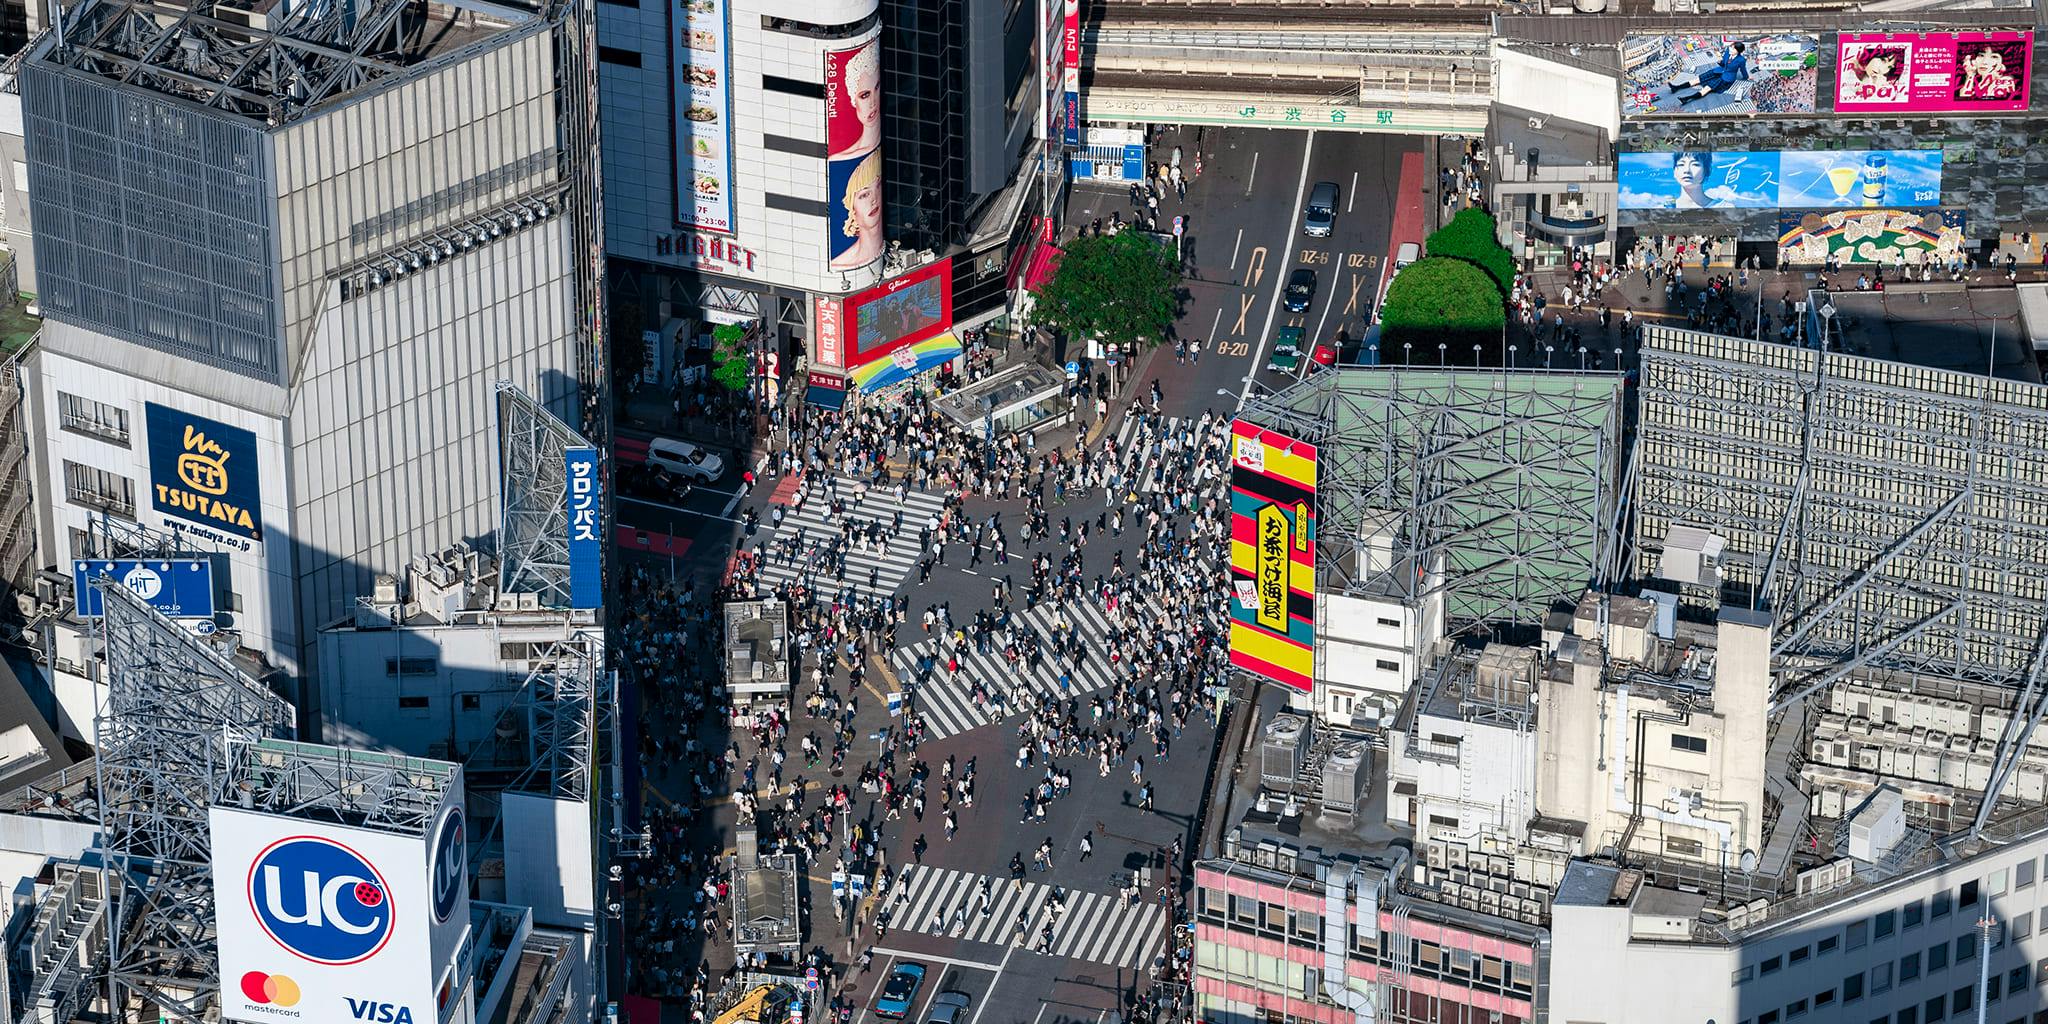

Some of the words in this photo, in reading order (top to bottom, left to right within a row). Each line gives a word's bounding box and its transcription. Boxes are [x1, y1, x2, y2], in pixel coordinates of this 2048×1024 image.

[827, 53, 838, 78] 4.28
[827, 82, 838, 118] Debut!
[1637, 94, 1651, 103] 50
[1239, 106, 1257, 117] JR
[1286, 107, 1393, 124] 渋谷駅
[697, 206, 709, 214] 7F
[656, 231, 758, 272] MAGNET
[821, 308, 836, 365] 天津甘栗
[1217, 341, 1250, 357] 8-20
[811, 375, 842, 388] 天津甘栗
[156, 483, 255, 529] TSUTAYA
[571, 461, 596, 541] サロンパス
[163, 518, 251, 552] www.tsutaya.co.jp
[129, 572, 156, 594] HiT
[1263, 516, 1283, 622] お茶づけ海苔
[263, 864, 382, 936] UC
[244, 1003, 301, 1019] mastercard
[341, 996, 415, 1024] VISA
